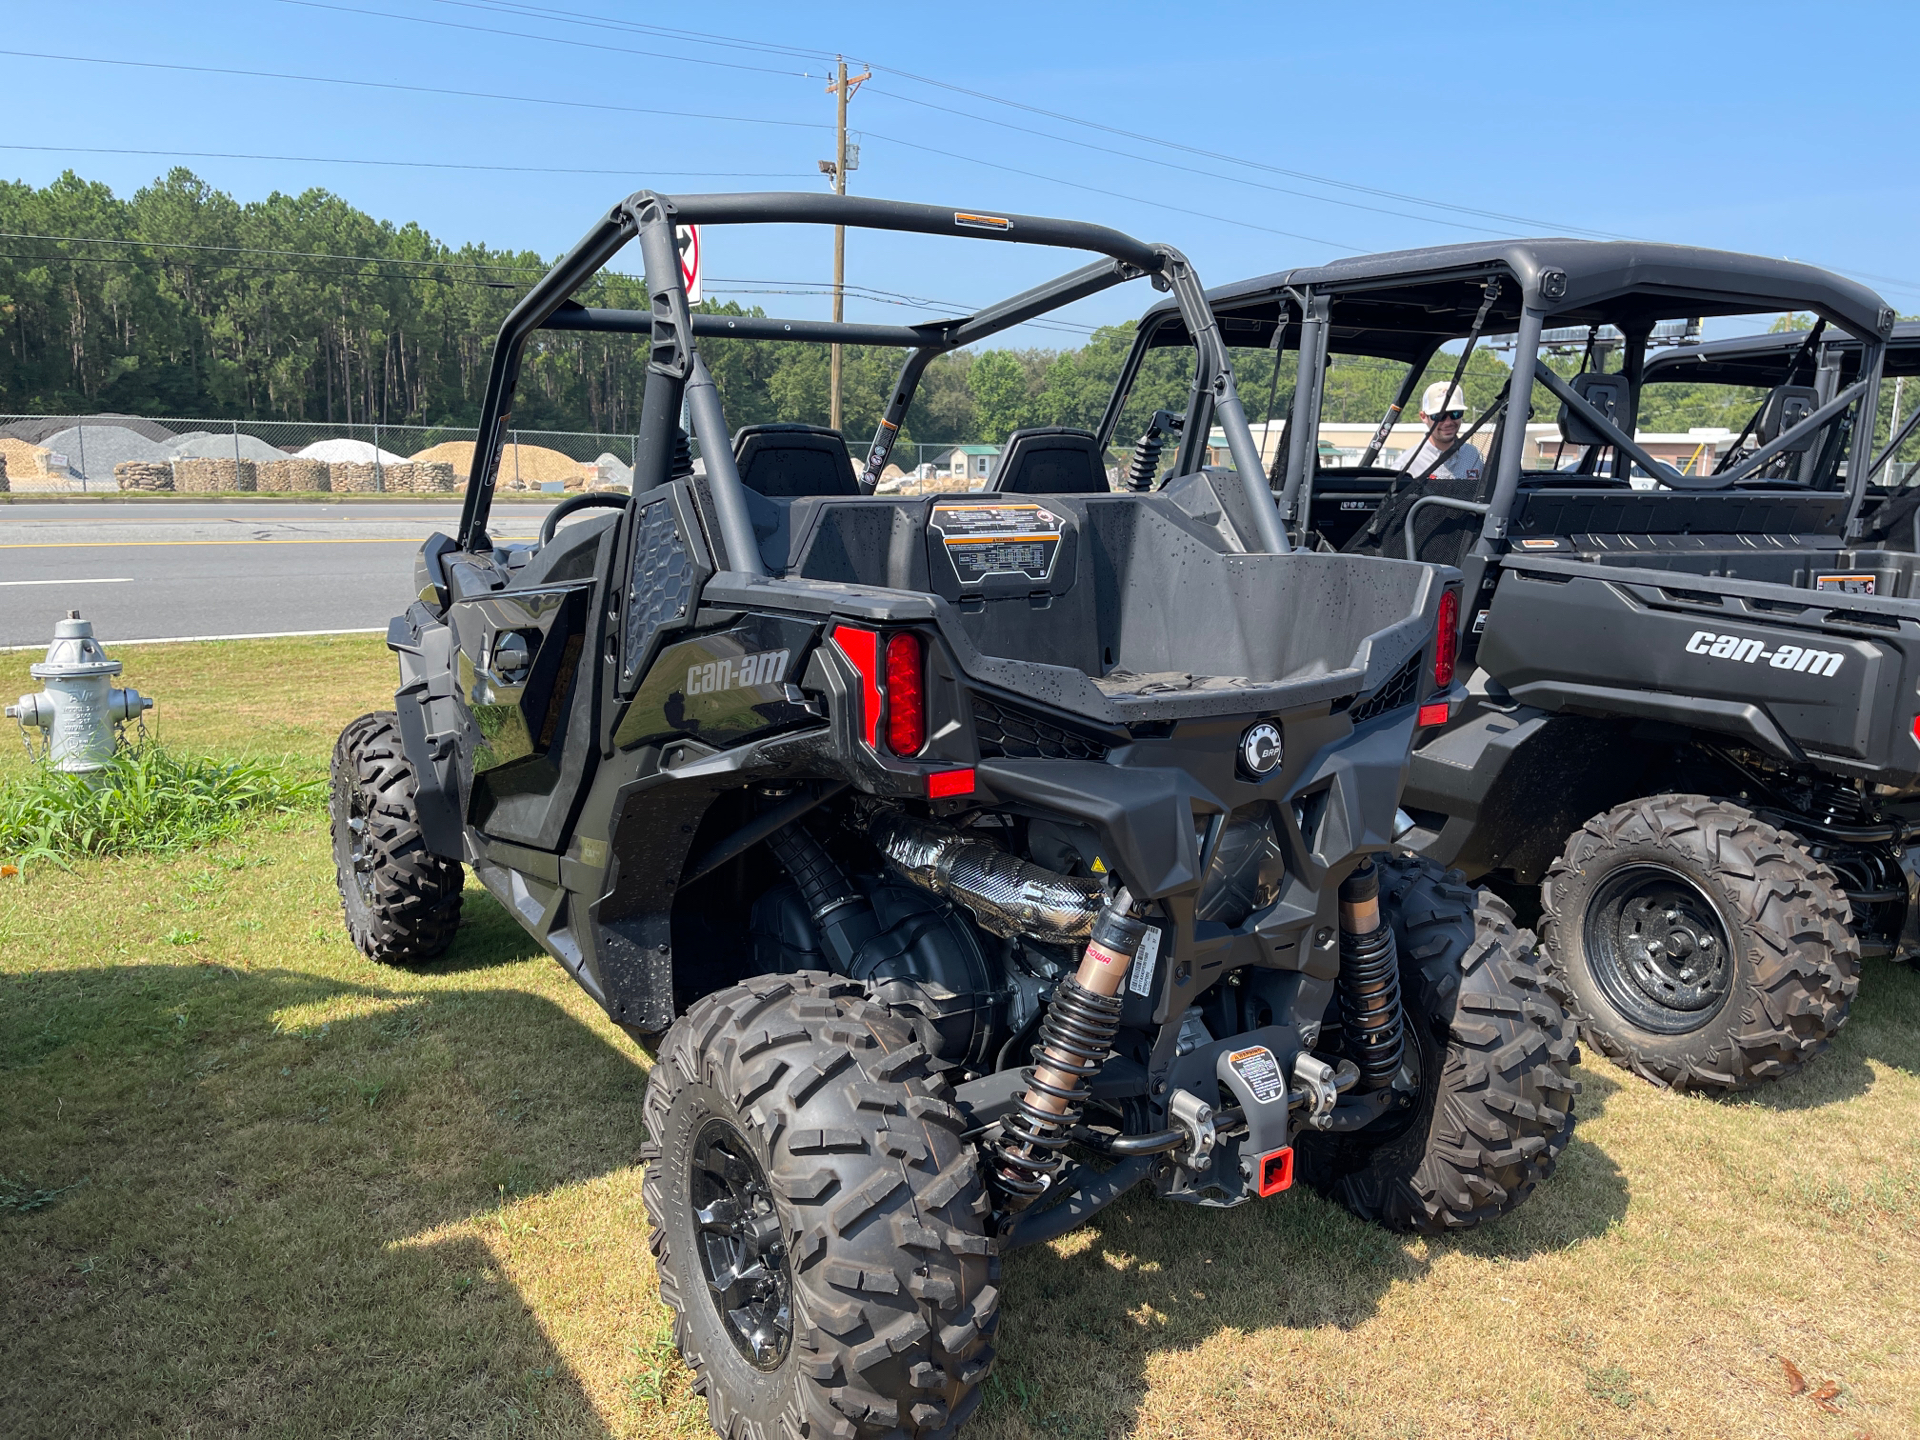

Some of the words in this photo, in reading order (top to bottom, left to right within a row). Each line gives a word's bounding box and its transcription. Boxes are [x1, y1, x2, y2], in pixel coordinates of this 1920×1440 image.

[686, 649, 790, 696] can-am
[1685, 629, 1846, 678] can-am
[1261, 748, 1280, 758] BRP
